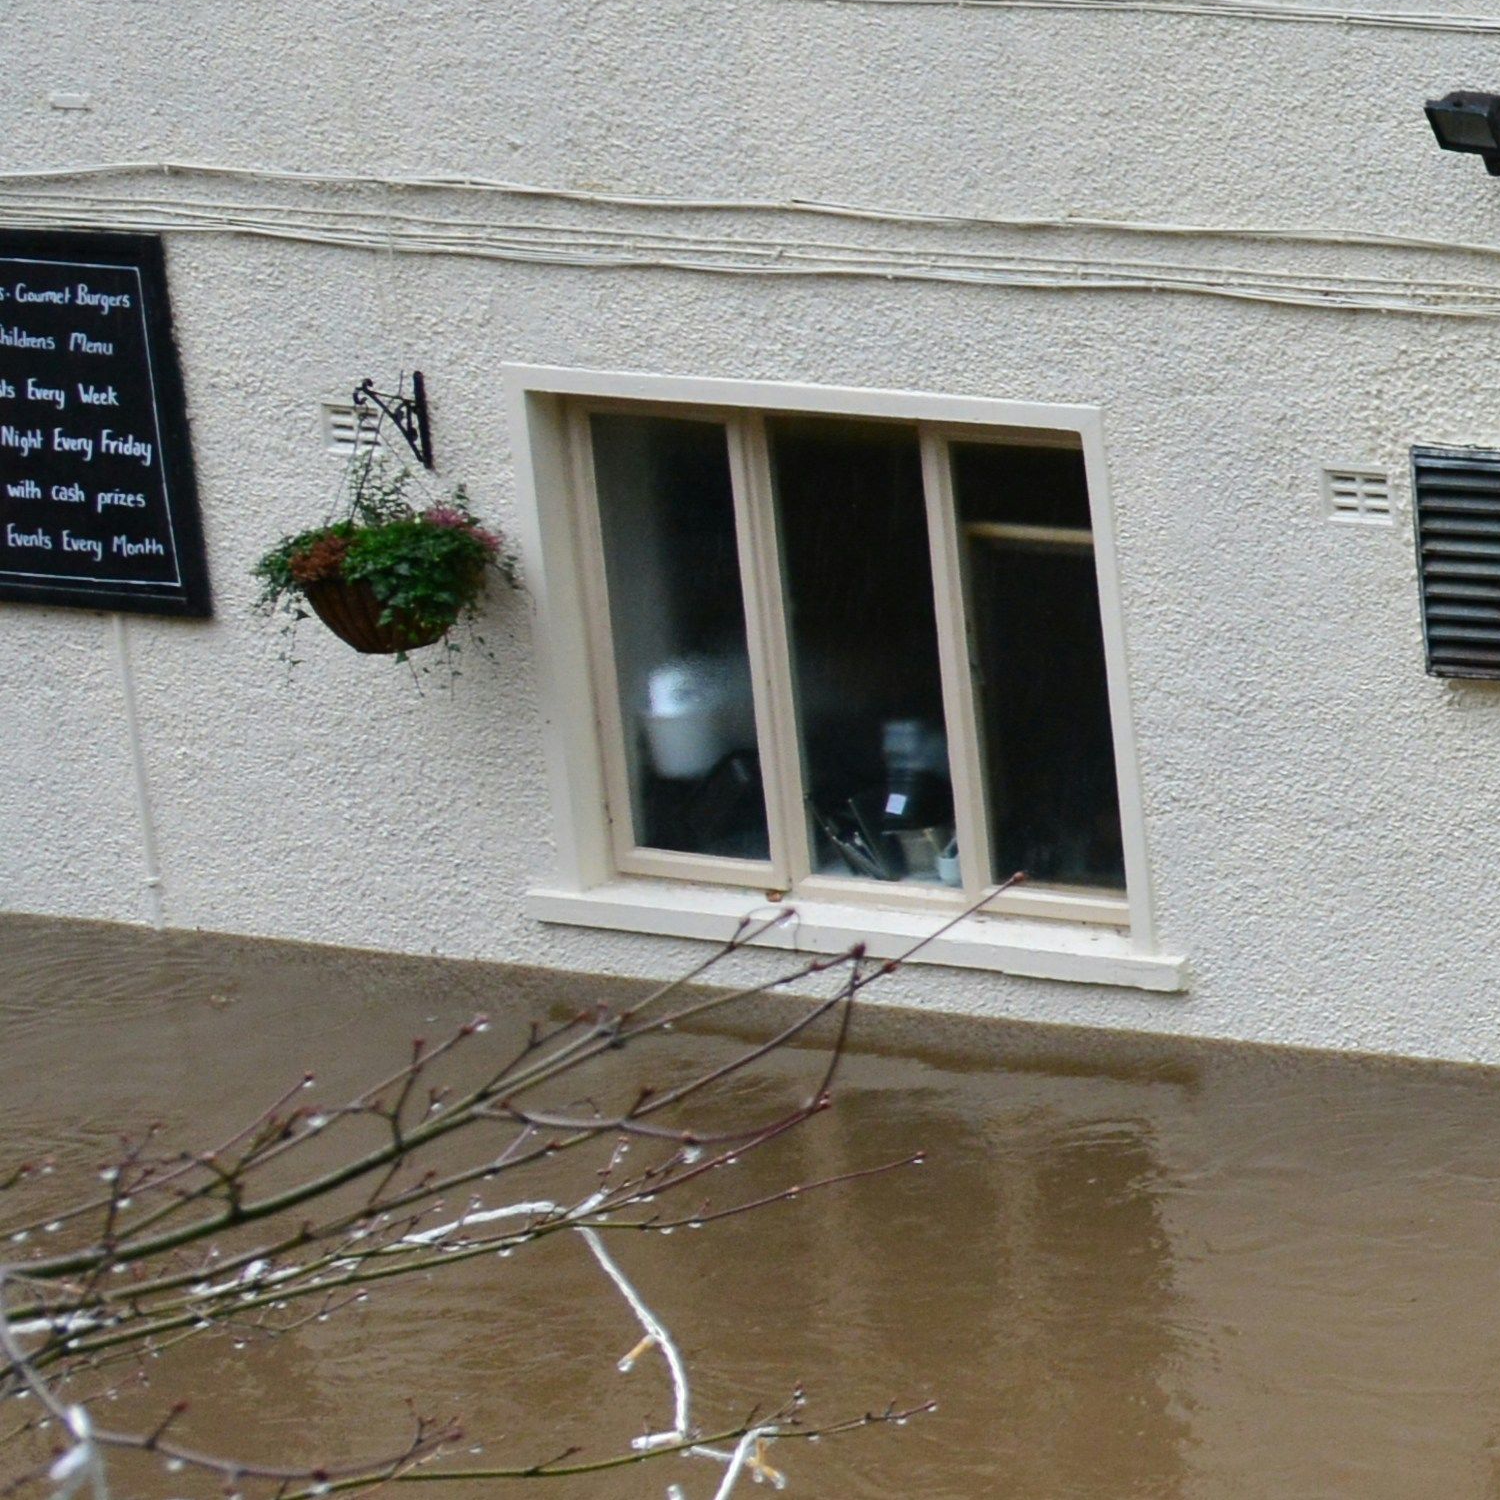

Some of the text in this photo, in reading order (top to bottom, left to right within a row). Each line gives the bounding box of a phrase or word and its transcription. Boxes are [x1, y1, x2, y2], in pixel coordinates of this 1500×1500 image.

[15, 283, 70, 304] Gourmet
[76, 283, 131, 315] Burgers
[0, 324, 113, 355] hildrens Menu
[27, 378, 65, 410] Every
[78, 383, 119, 406] Week
[1, 425, 152, 466] Night Every Friday
[7, 479, 146, 513] with cash prizes
[7, 523, 164, 562] Events Every Month
